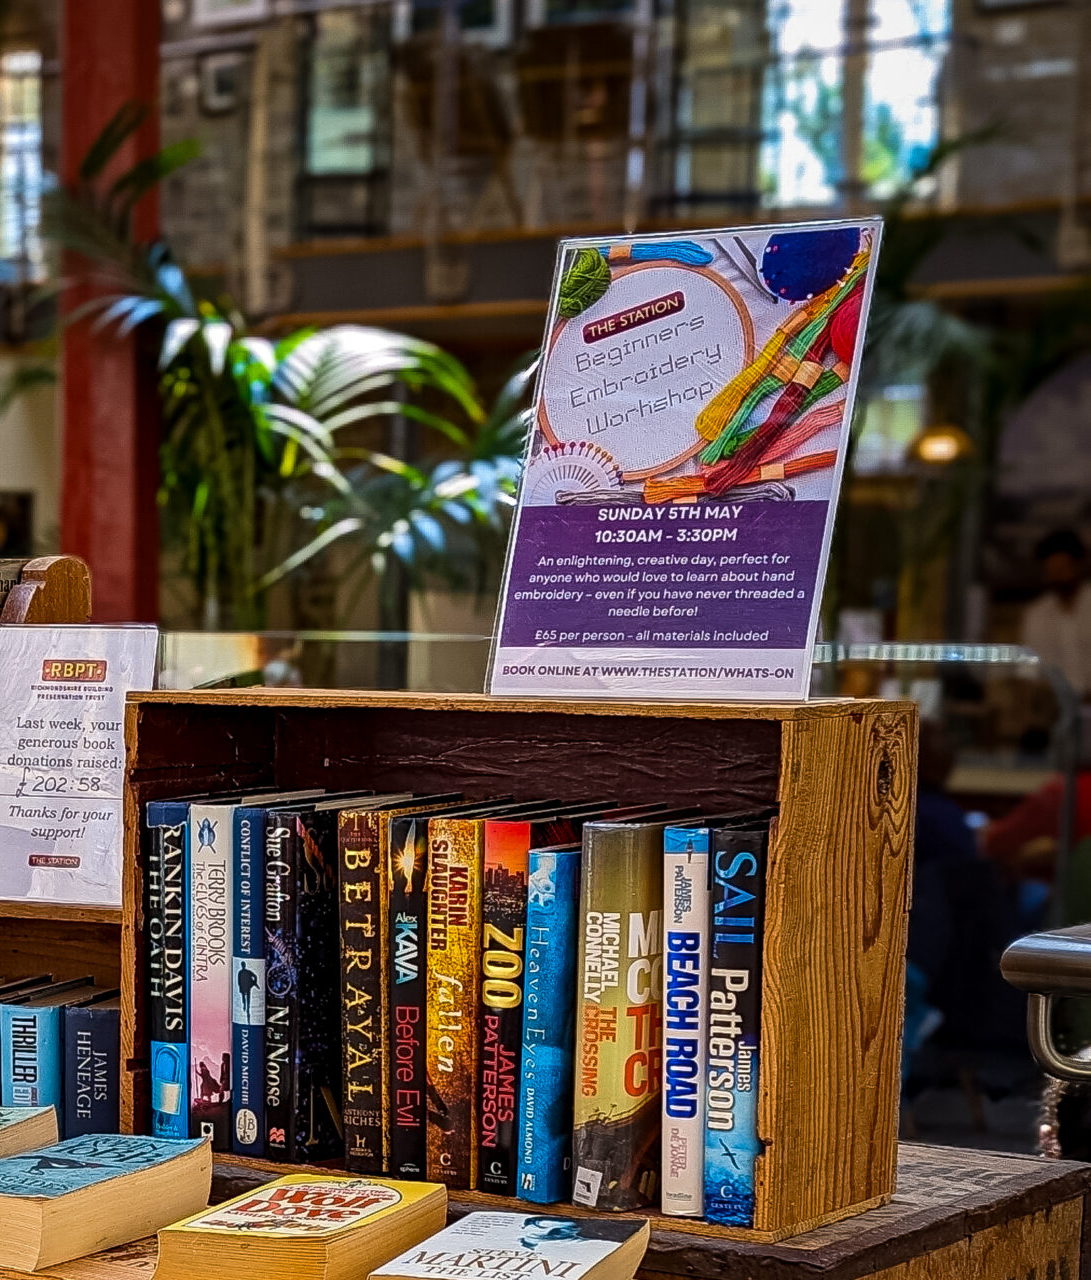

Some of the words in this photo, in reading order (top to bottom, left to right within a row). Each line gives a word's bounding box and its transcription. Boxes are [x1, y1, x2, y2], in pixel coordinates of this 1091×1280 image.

[588, 316, 616, 338] THE
[619, 297, 680, 328] STATION
[575, 314, 706, 373] Beginners
[570, 343, 722, 408] Embroidery
[586, 381, 714, 435] Workshop
[598, 508, 665, 521] SUNDAY
[669, 508, 703, 520] 5TH
[707, 506, 742, 519] MAY
[595, 530, 662, 543] 10:30AM
[676, 529, 737, 542] 3:30PM
[538, 555, 553, 566] An
[556, 554, 634, 567] enlightening,
[637, 555, 688, 566] creative
[691, 554, 716, 567] day,
[720, 553, 768, 567] perfect
[771, 553, 790, 564] for
[529, 573, 571, 585] anyone
[575, 572, 599, 583] who
[603, 572, 639, 583] would
[642, 571, 666, 582] love
[670, 572, 683, 582] to
[686, 571, 717, 582] learn
[721, 570, 758, 581] about
[762, 570, 794, 581] hand
[514, 589, 583, 602] embroidery
[595, 590, 623, 599] even
[626, 588, 635, 599] if
[638, 590, 660, 601] you
[663, 588, 693, 599] have
[696, 589, 731, 599] never
[735, 588, 794, 599] threaded
[797, 590, 805, 598] a
[608, 606, 649, 617] needle
[653, 606, 698, 617] before!
[535, 630, 557, 640] £65
[560, 632, 580, 644] per
[583, 632, 624, 644] person
[636, 630, 651, 641] all
[653, 630, 710, 641] materials
[714, 630, 768, 641] included
[51, 663, 96, 677] RBPT
[503, 666, 535, 675] BOOK
[538, 666, 580, 676] ONLINE
[583, 667, 598, 676] AT
[601, 667, 794, 679] WWW.THESTATION/WHATS-ON
[16, 717, 44, 730] Last
[49, 718, 85, 731] week,
[90, 721, 121, 733] your
[18, 738, 78, 749] generous
[83, 738, 115, 750] book
[8, 755, 73, 767] donations
[77, 757, 121, 768] raised:
[9, 806, 57, 819] Thanks
[59, 807, 78, 821] for
[82, 810, 113, 822] your
[30, 827, 85, 840] support!
[240, 819, 251, 878] CONFLICT
[48, 857, 78, 865] STATION
[208, 859, 226, 907] TERRY
[241, 880, 250, 894] OF
[714, 850, 757, 959] SAIL
[208, 909, 226, 965] BROOKS
[242, 897, 251, 954] INTEREST
[395, 925, 419, 984] KAVA
[482, 923, 523, 1009] ZOO
[667, 931, 701, 1031] BEACH
[707, 968, 749, 1130] Patterson
[482, 1015, 500, 1149] PATTERSON
[499, 1045, 515, 1122] JAMES
[665, 1039, 698, 1118] ROAD
[736, 1042, 752, 1092] James
[403, 1251, 582, 1279] MARTINI
